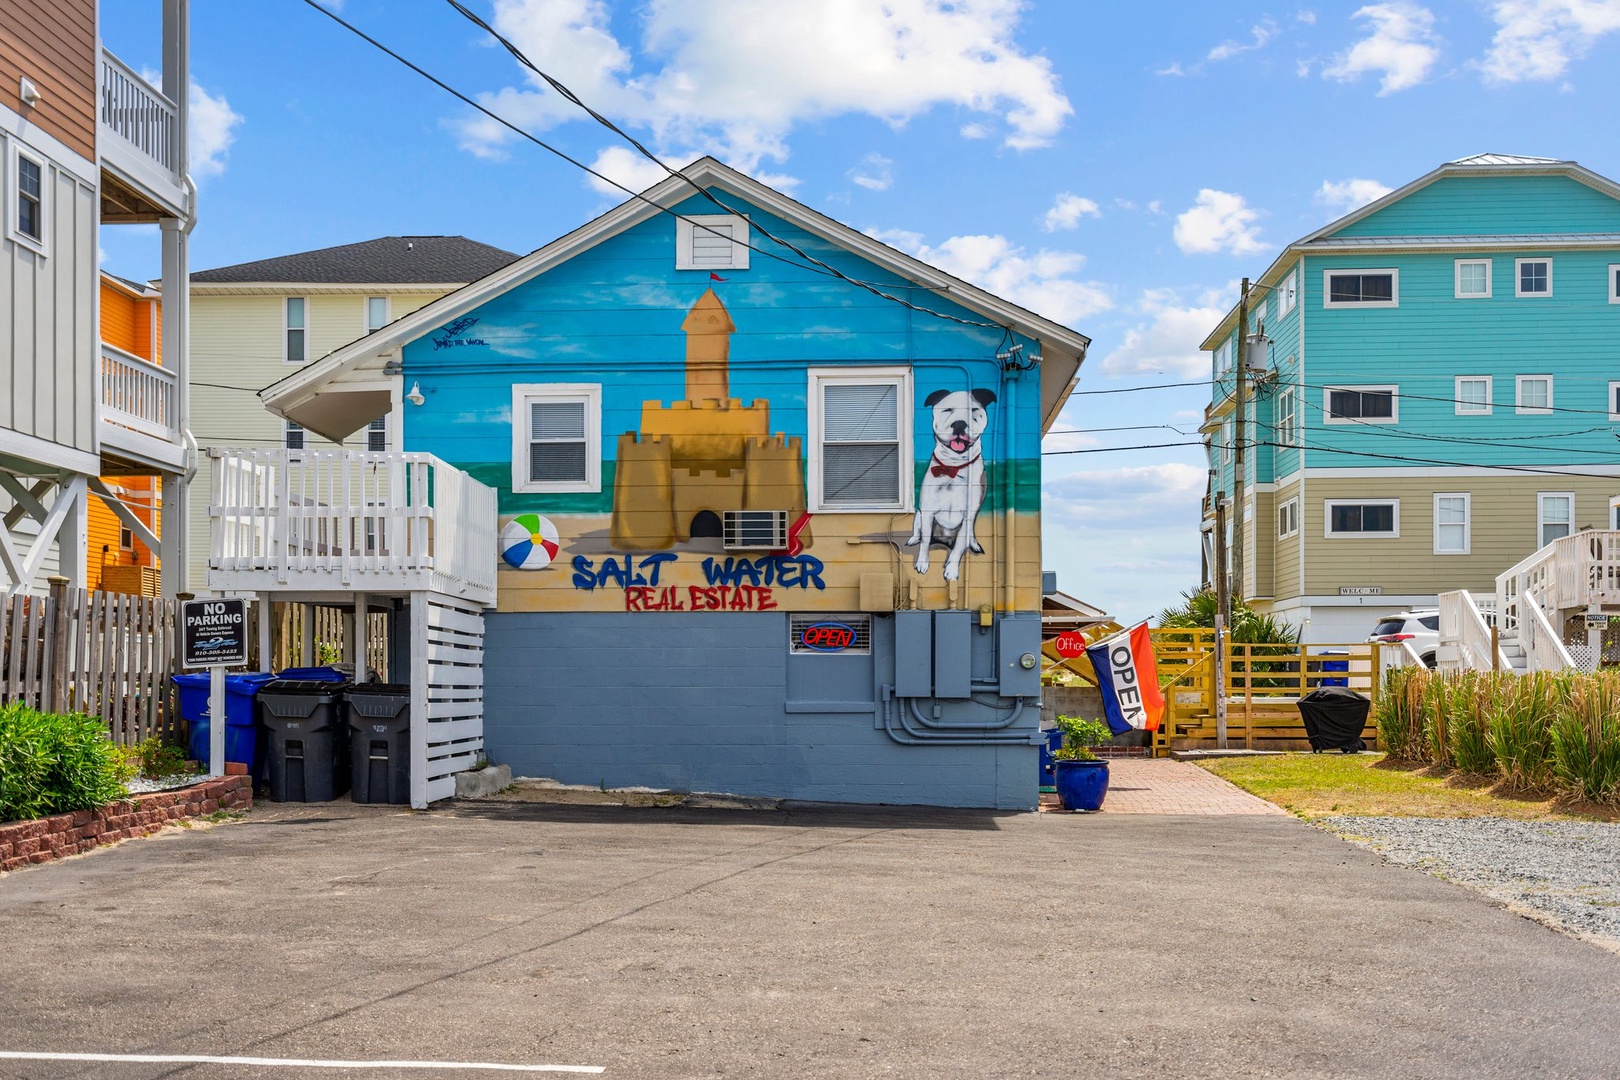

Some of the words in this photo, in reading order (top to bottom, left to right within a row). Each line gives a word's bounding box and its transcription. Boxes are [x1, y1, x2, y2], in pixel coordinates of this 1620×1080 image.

[571, 553, 678, 590] SALT
[702, 554, 826, 590] WATER
[204, 602, 226, 615] NO
[624, 585, 685, 611] REAL
[688, 585, 778, 611] ESTATE
[187, 614, 242, 626] PARKING
[803, 626, 853, 647] OPEN
[1056, 637, 1085, 651] Office
[1110, 646, 1142, 721] OPEN
